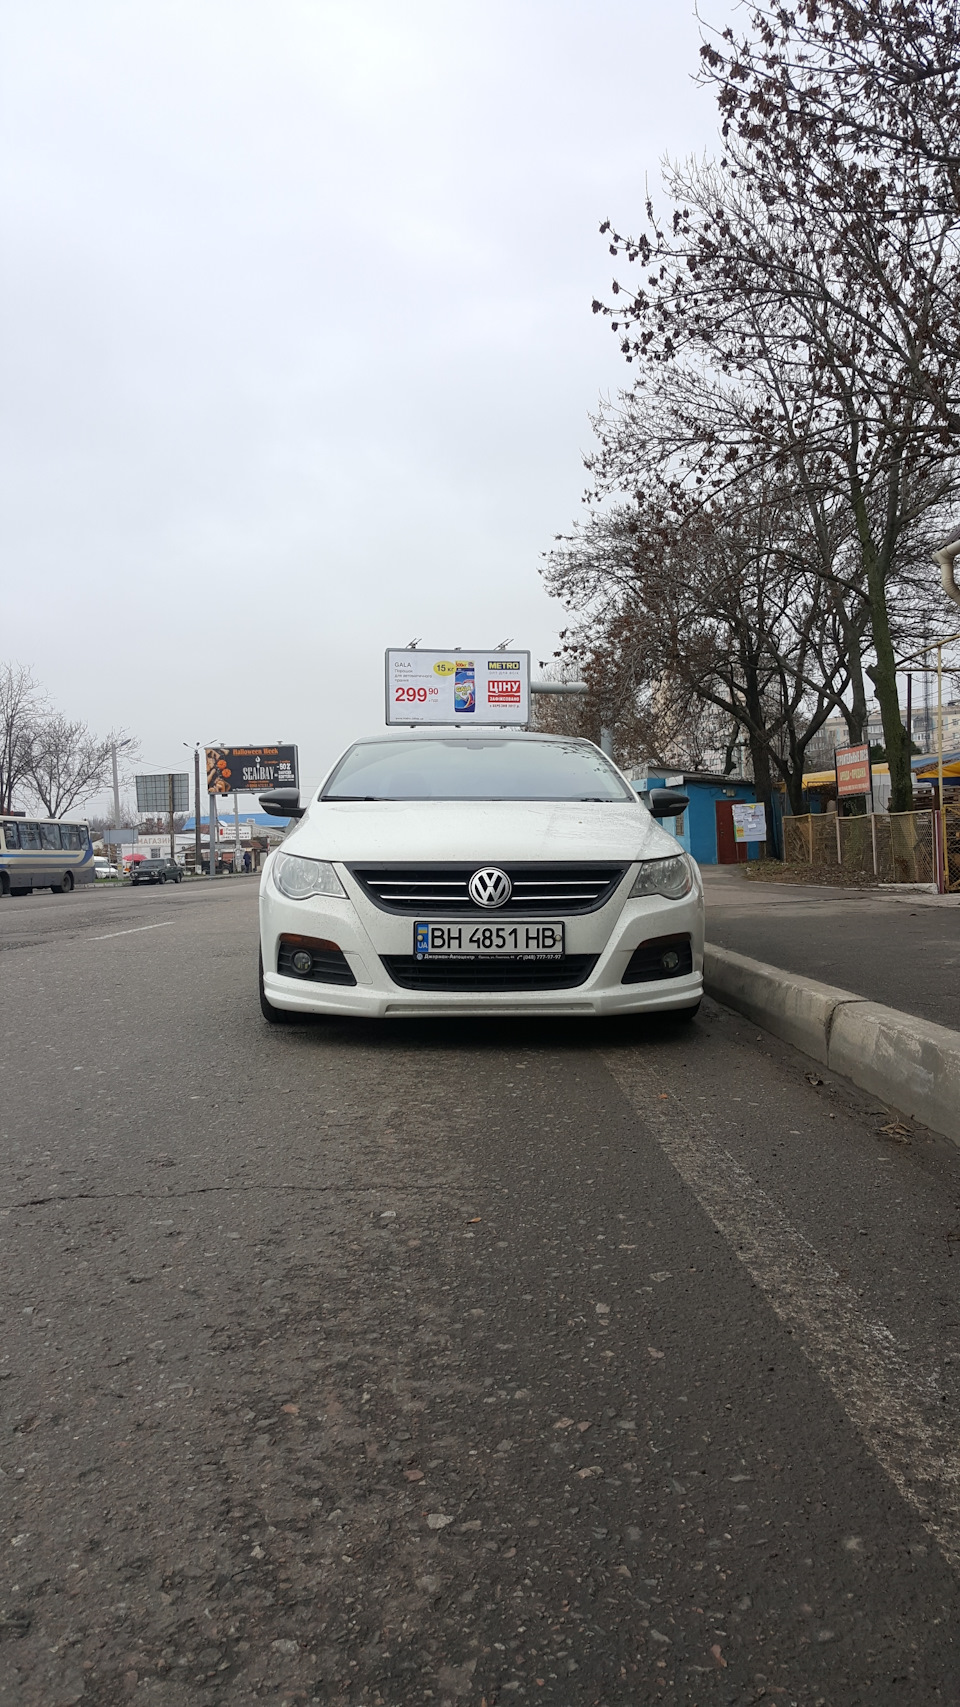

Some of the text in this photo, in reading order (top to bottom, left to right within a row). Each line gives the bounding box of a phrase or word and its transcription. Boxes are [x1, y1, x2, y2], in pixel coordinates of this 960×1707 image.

[436, 664, 446, 672] 15
[488, 662, 519, 670] METRO
[489, 682, 520, 694] ЦІНУ
[395, 687, 428, 703] 299
[232, 747, 278, 756] Halloween Week
[431, 927, 556, 949] BH 4851 HB
[417, 941, 428, 949] UA
